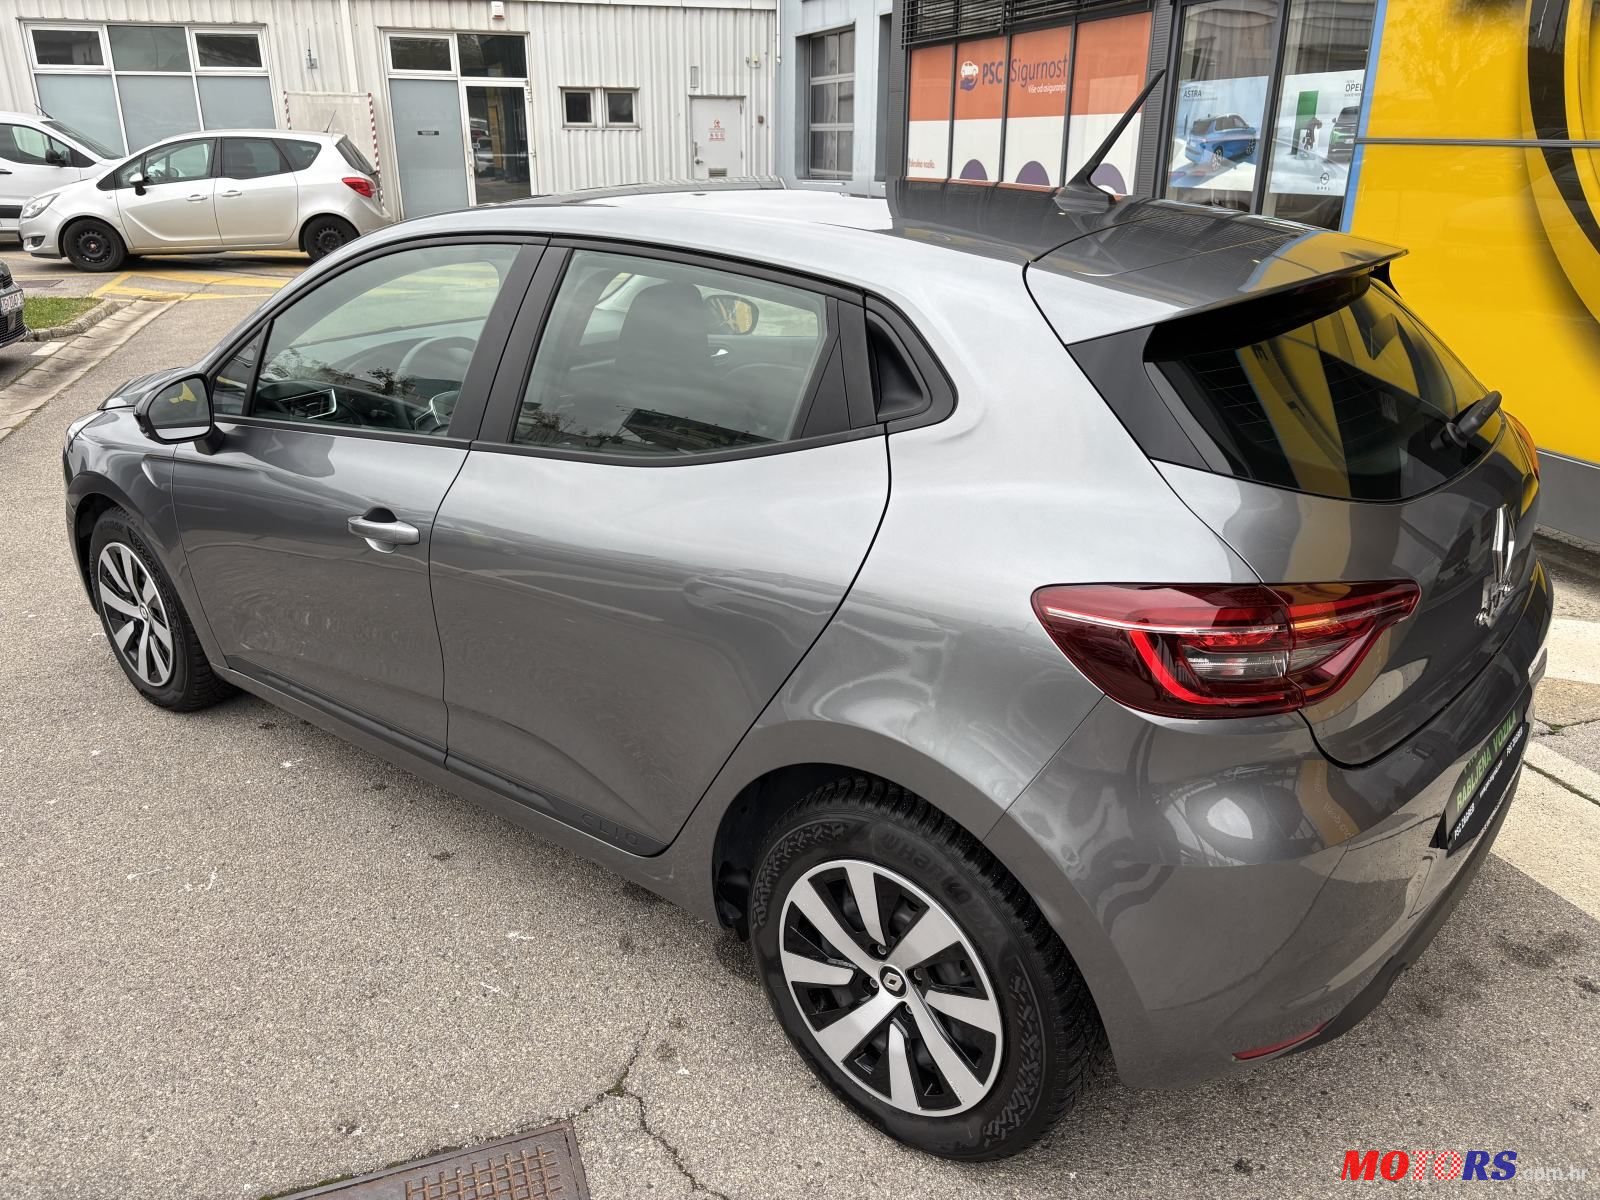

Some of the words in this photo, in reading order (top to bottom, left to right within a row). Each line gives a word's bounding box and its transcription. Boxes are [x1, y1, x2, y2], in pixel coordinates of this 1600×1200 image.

[982, 61, 1003, 85] PSC
[1010, 54, 1068, 87] Sigurnost
[1184, 89, 1202, 97] ASTRA
[1456, 746, 1492, 813] RABLJENA
[1493, 710, 1516, 752] VOZILA
